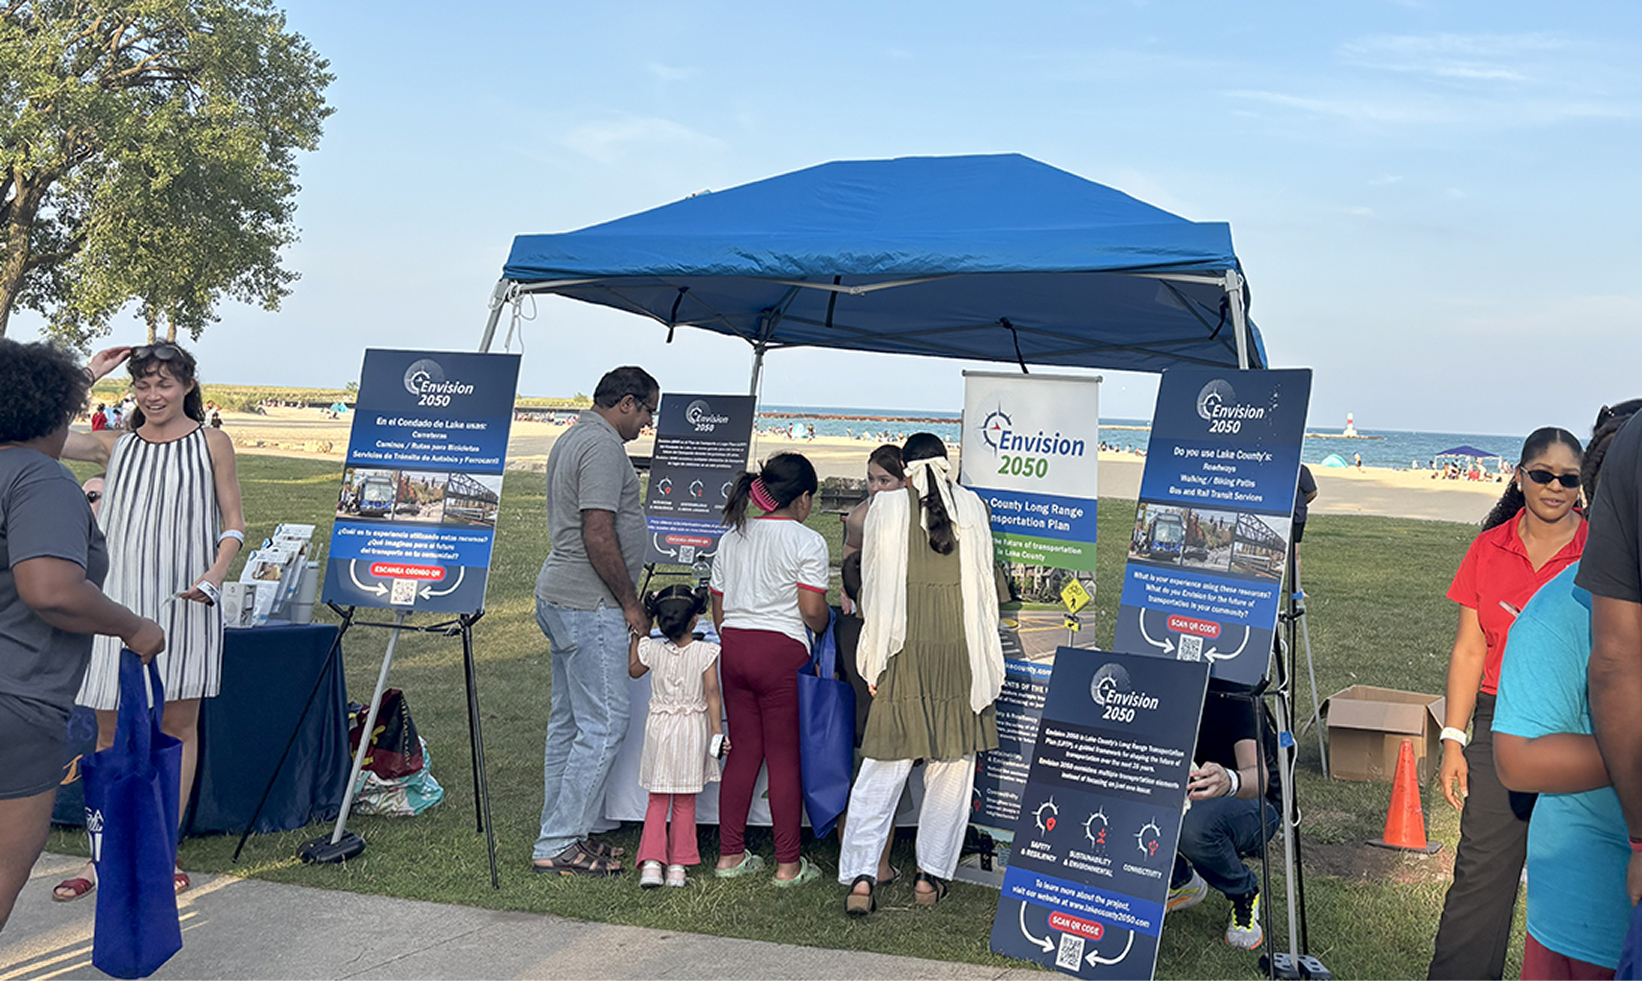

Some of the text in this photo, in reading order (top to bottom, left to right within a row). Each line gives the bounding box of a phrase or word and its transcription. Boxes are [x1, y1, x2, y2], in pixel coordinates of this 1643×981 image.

[421, 380, 475, 395] Envision
[418, 394, 451, 407] 2050
[696, 413, 730, 424] Envision
[1212, 404, 1265, 420] Envision
[376, 417, 387, 425] En
[388, 418, 397, 426] el
[397, 418, 432, 428] Condado
[433, 420, 444, 428] de
[445, 420, 465, 429] Lake
[1209, 420, 1241, 434] 2050
[411, 431, 447, 440] Carreteras
[1000, 430, 1085, 457] Envision
[1174, 446, 1272, 462] Do you use Lake County's:
[998, 455, 1049, 478] 2050
[1203, 462, 1237, 474] Roadways
[1180, 474, 1208, 485] Walking
[1213, 476, 1236, 488] Biking
[1236, 478, 1256, 488] Paths
[1169, 486, 1263, 502] Bus and Rail Transit Services
[991, 498, 1024, 512] County
[1025, 502, 1050, 516] Long
[1051, 503, 1084, 519] Range
[991, 514, 1070, 531] nsportation Plan
[1005, 548, 1021, 558] Lake
[1021, 550, 1046, 562] County
[1024, 541, 1033, 549] of
[1033, 542, 1083, 555] transportation
[1171, 619, 1188, 628] SCAN
[1199, 623, 1217, 634] CODE
[1106, 689, 1159, 710] Envision
[1102, 705, 1136, 723] 2050
[1030, 840, 1052, 852] SAFETY
[1012, 886, 1026, 895] visit
[1026, 890, 1037, 898] our
[1037, 893, 1061, 904] website
[1043, 881, 1059, 892] learn
[1060, 887, 1076, 897] more
[1076, 891, 1095, 901] about
[1095, 895, 1106, 904] the
[1052, 916, 1100, 936] SCAN QR CODE
